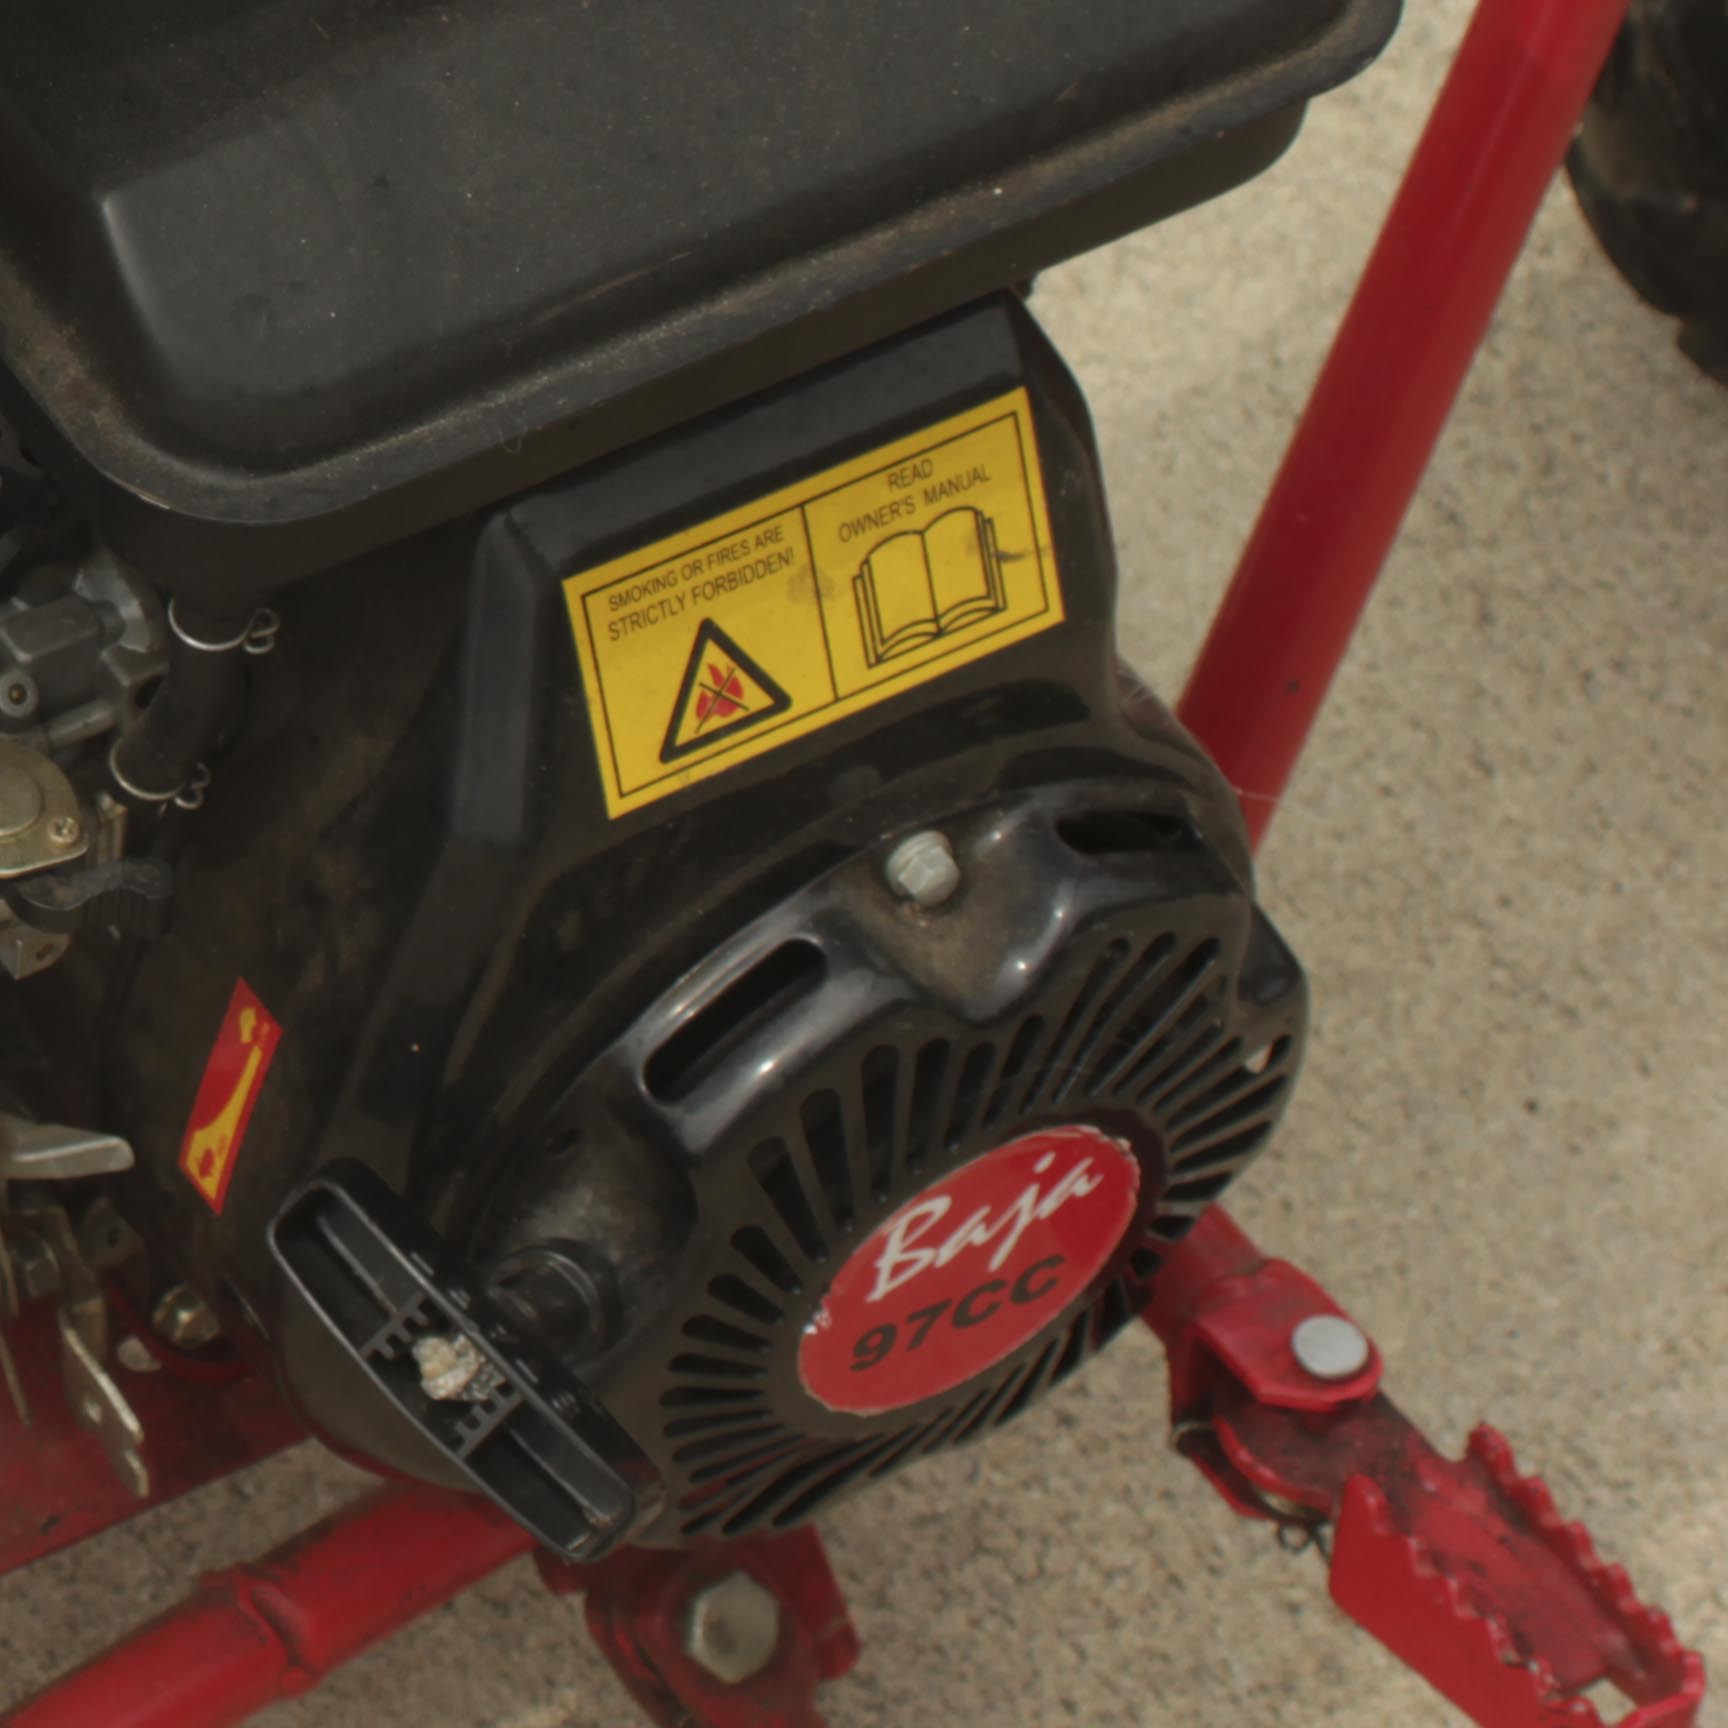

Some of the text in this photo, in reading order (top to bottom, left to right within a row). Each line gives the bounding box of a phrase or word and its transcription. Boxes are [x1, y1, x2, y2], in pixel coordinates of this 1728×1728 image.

[836, 463, 992, 544] OWNER'S MANUAL
[886, 458, 936, 494] READ
[607, 525, 786, 613] SMOKING OR FIRES ARE
[607, 547, 796, 642] STRICTLY FORBIDDEN!
[865, 1150, 1105, 1304] Baja
[848, 1254, 1066, 1373] 97CC
